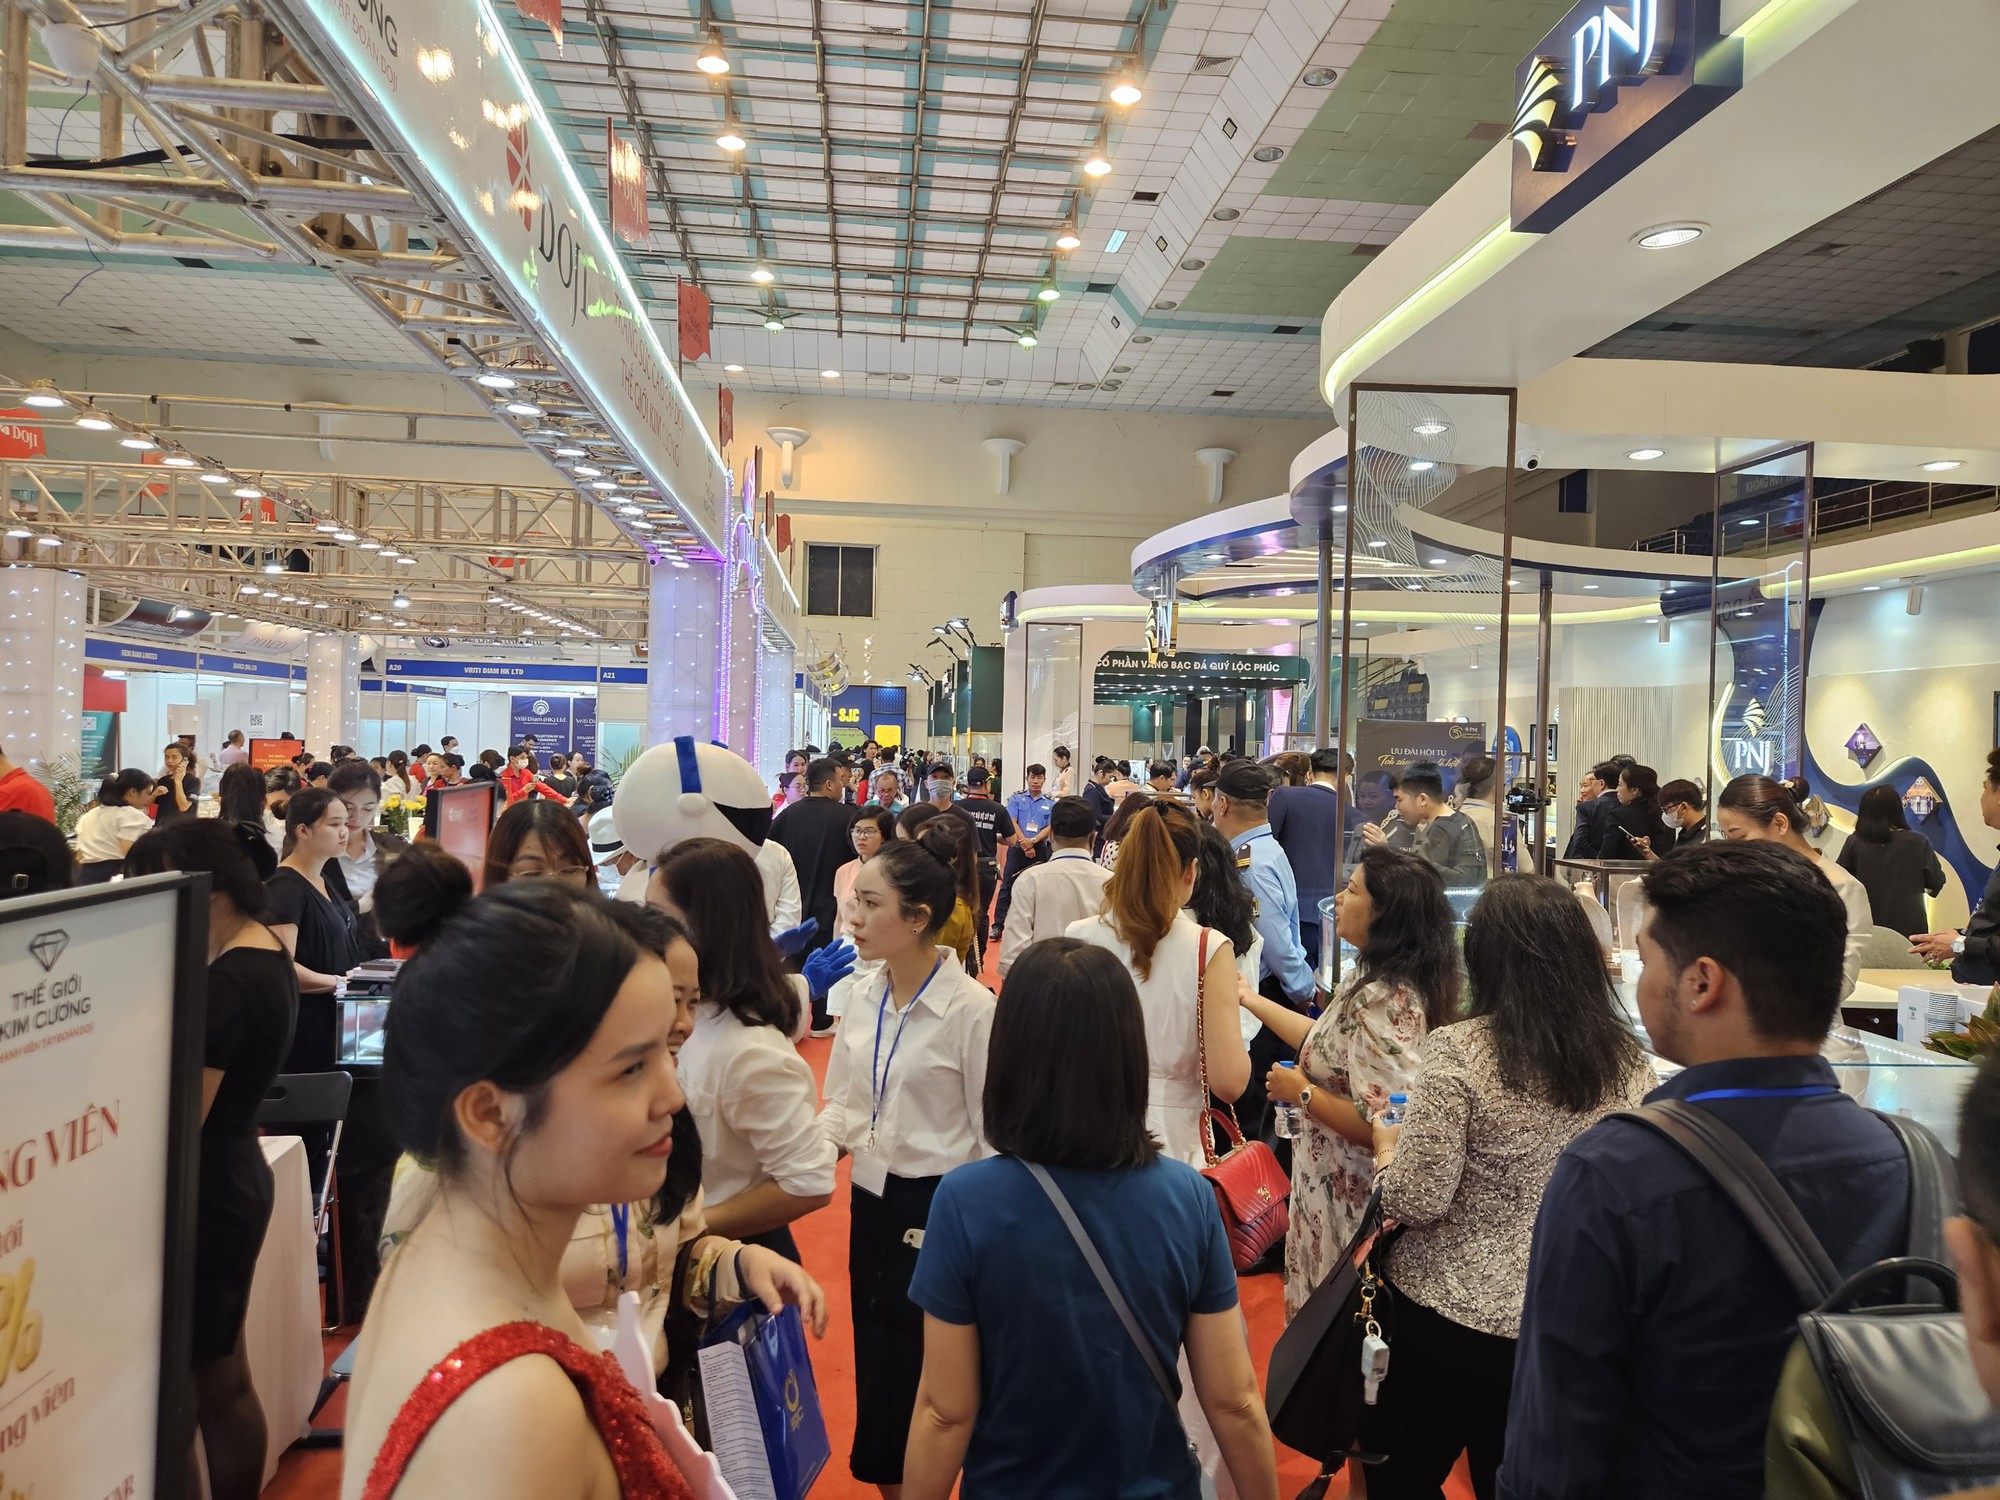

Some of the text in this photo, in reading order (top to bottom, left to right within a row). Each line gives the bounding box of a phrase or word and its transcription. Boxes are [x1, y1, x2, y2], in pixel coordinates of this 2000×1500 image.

[357, 0, 398, 57] NG
[1570, 0, 1658, 111] PNJ
[539, 184, 589, 327] DOJI
[621, 357, 634, 401] THẾ
[12, 425, 39, 450] DOJI
[464, 666, 482, 674] VRITI
[482, 667, 500, 675] DIAM
[1112, 655, 1139, 668] PHẦN
[1171, 661, 1192, 672] BẠC
[1193, 659, 1208, 670] ĐÁ
[1209, 660, 1230, 671] QUÝ
[1231, 660, 1252, 673] LỘC
[1253, 660, 1280, 672] PHÚC
[838, 707, 860, 722] SJC
[1390, 747, 1403, 755] ƯU
[1419, 748, 1435, 757] HỘI
[1734, 740, 1772, 776] PNJ
[11, 973, 82, 1011] THẾ GIỚI
[0, 996, 91, 1040] KIM CƯƠNG
[45, 1098, 121, 1168] VIÊN
[31, 1376, 75, 1424] viên
